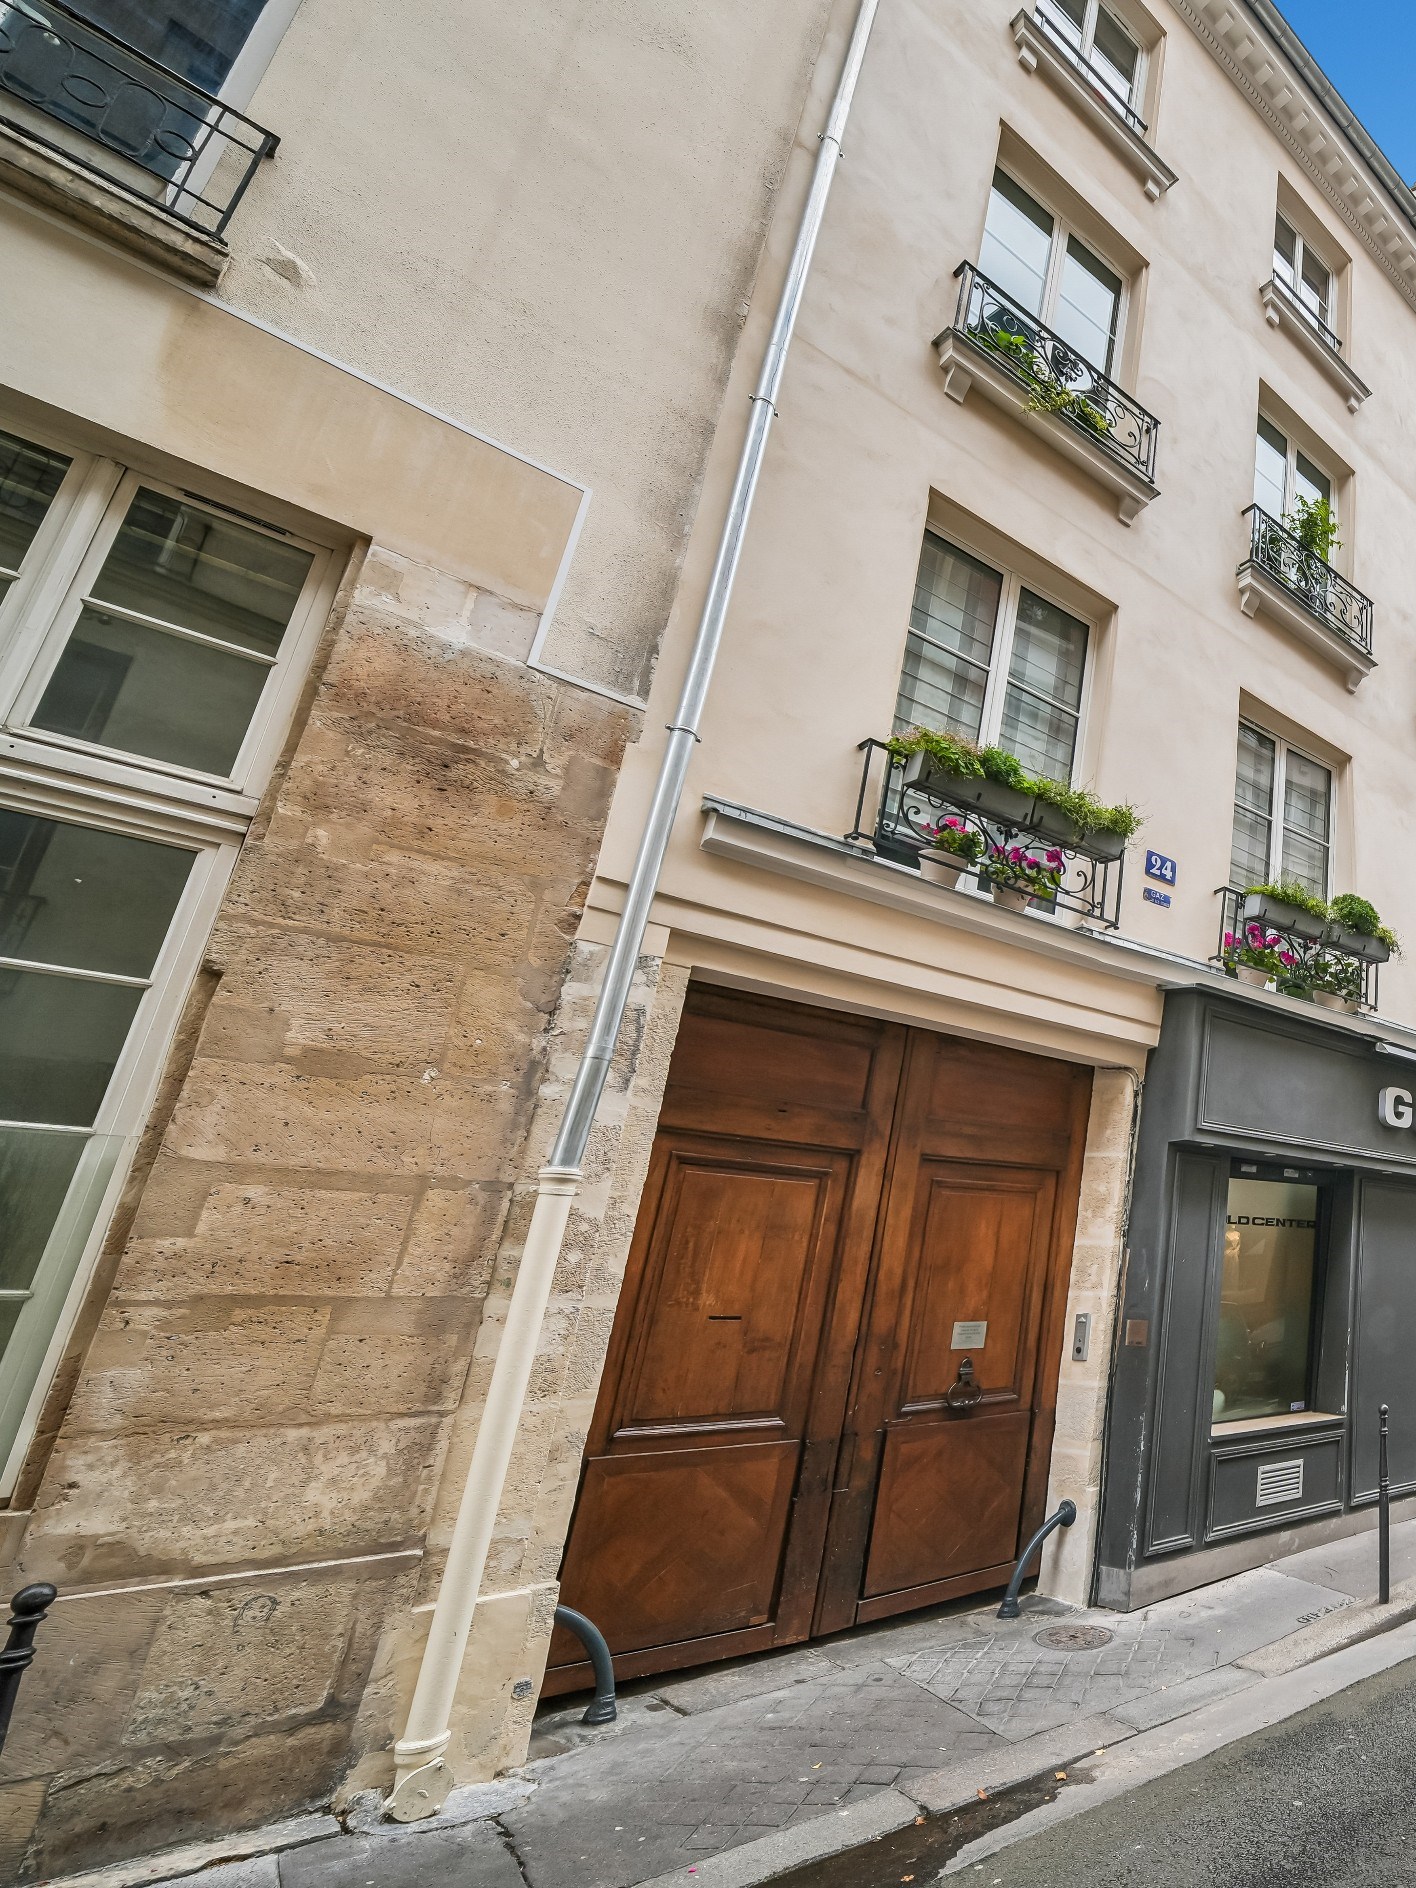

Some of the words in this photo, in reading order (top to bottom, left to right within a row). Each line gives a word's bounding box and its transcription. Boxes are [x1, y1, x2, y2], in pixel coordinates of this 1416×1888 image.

[1150, 855, 1173, 880] 24
[1150, 890, 1165, 901] GAZ
[1226, 1214, 1249, 1225] LD
